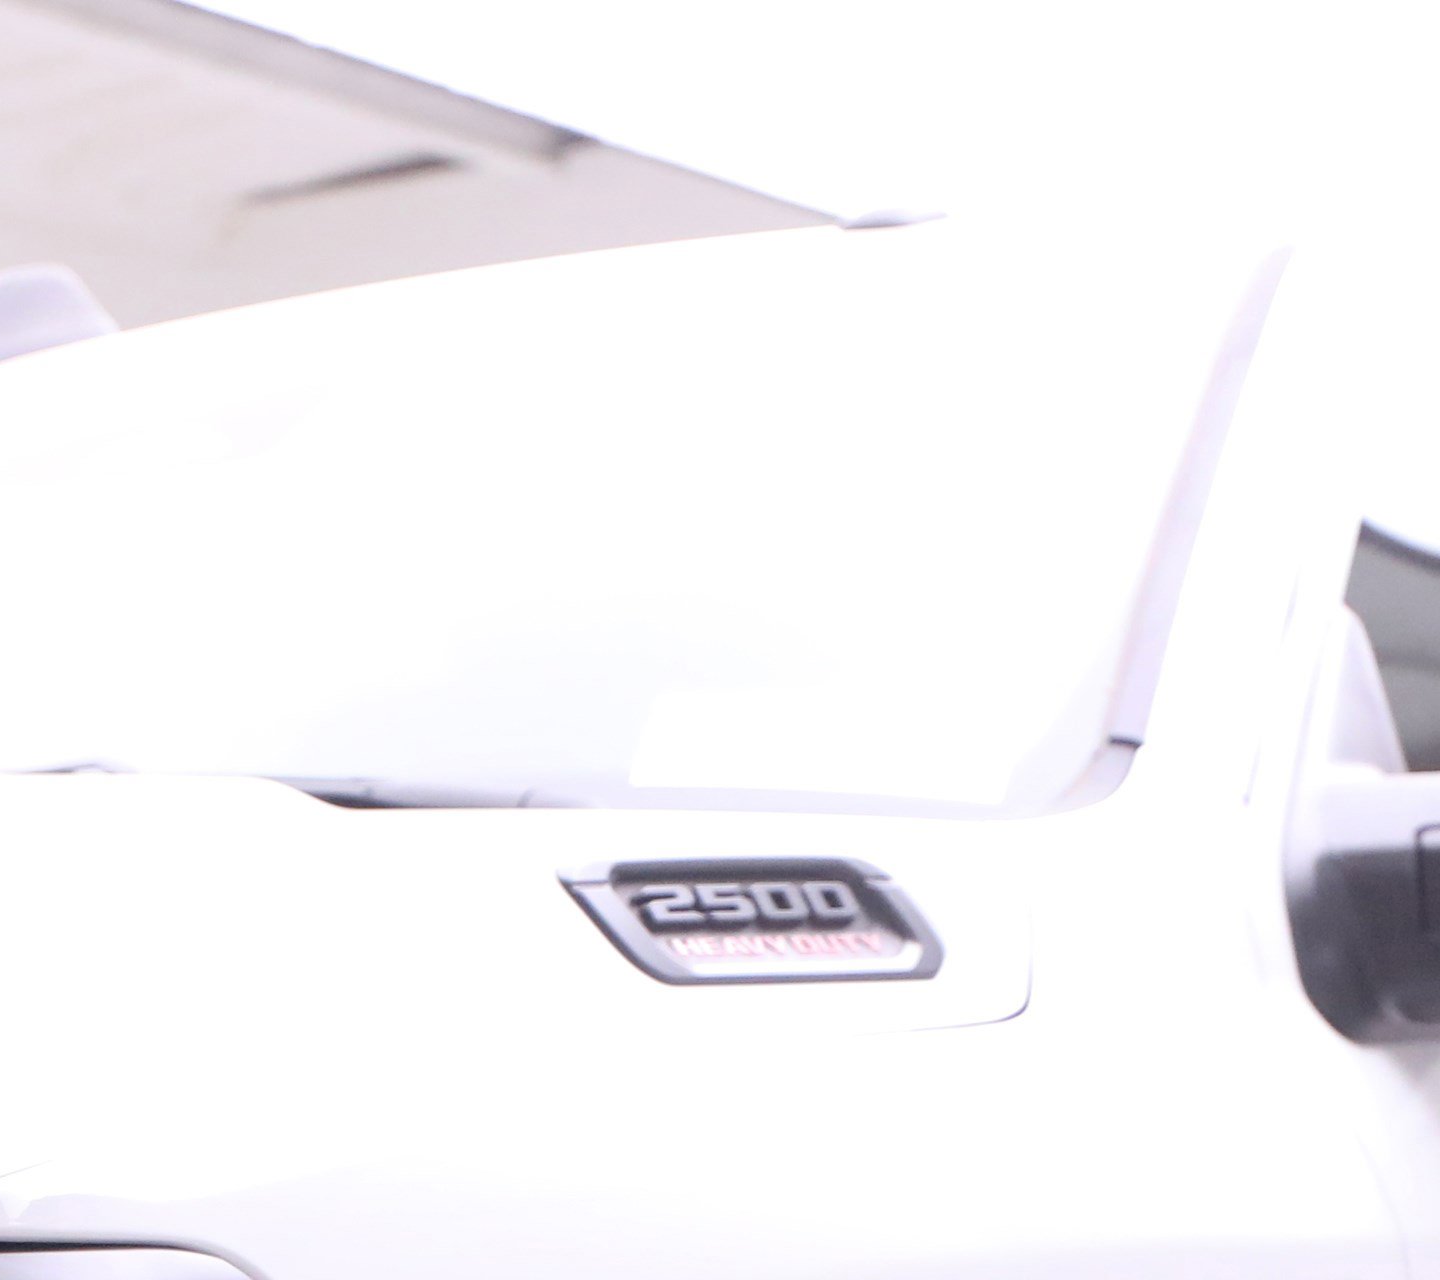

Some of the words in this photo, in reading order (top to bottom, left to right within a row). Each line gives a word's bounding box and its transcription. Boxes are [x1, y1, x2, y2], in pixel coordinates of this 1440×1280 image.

[634, 880, 860, 928] 2500
[668, 934, 789, 957] HEAVY
[791, 932, 884, 955] DUTY
